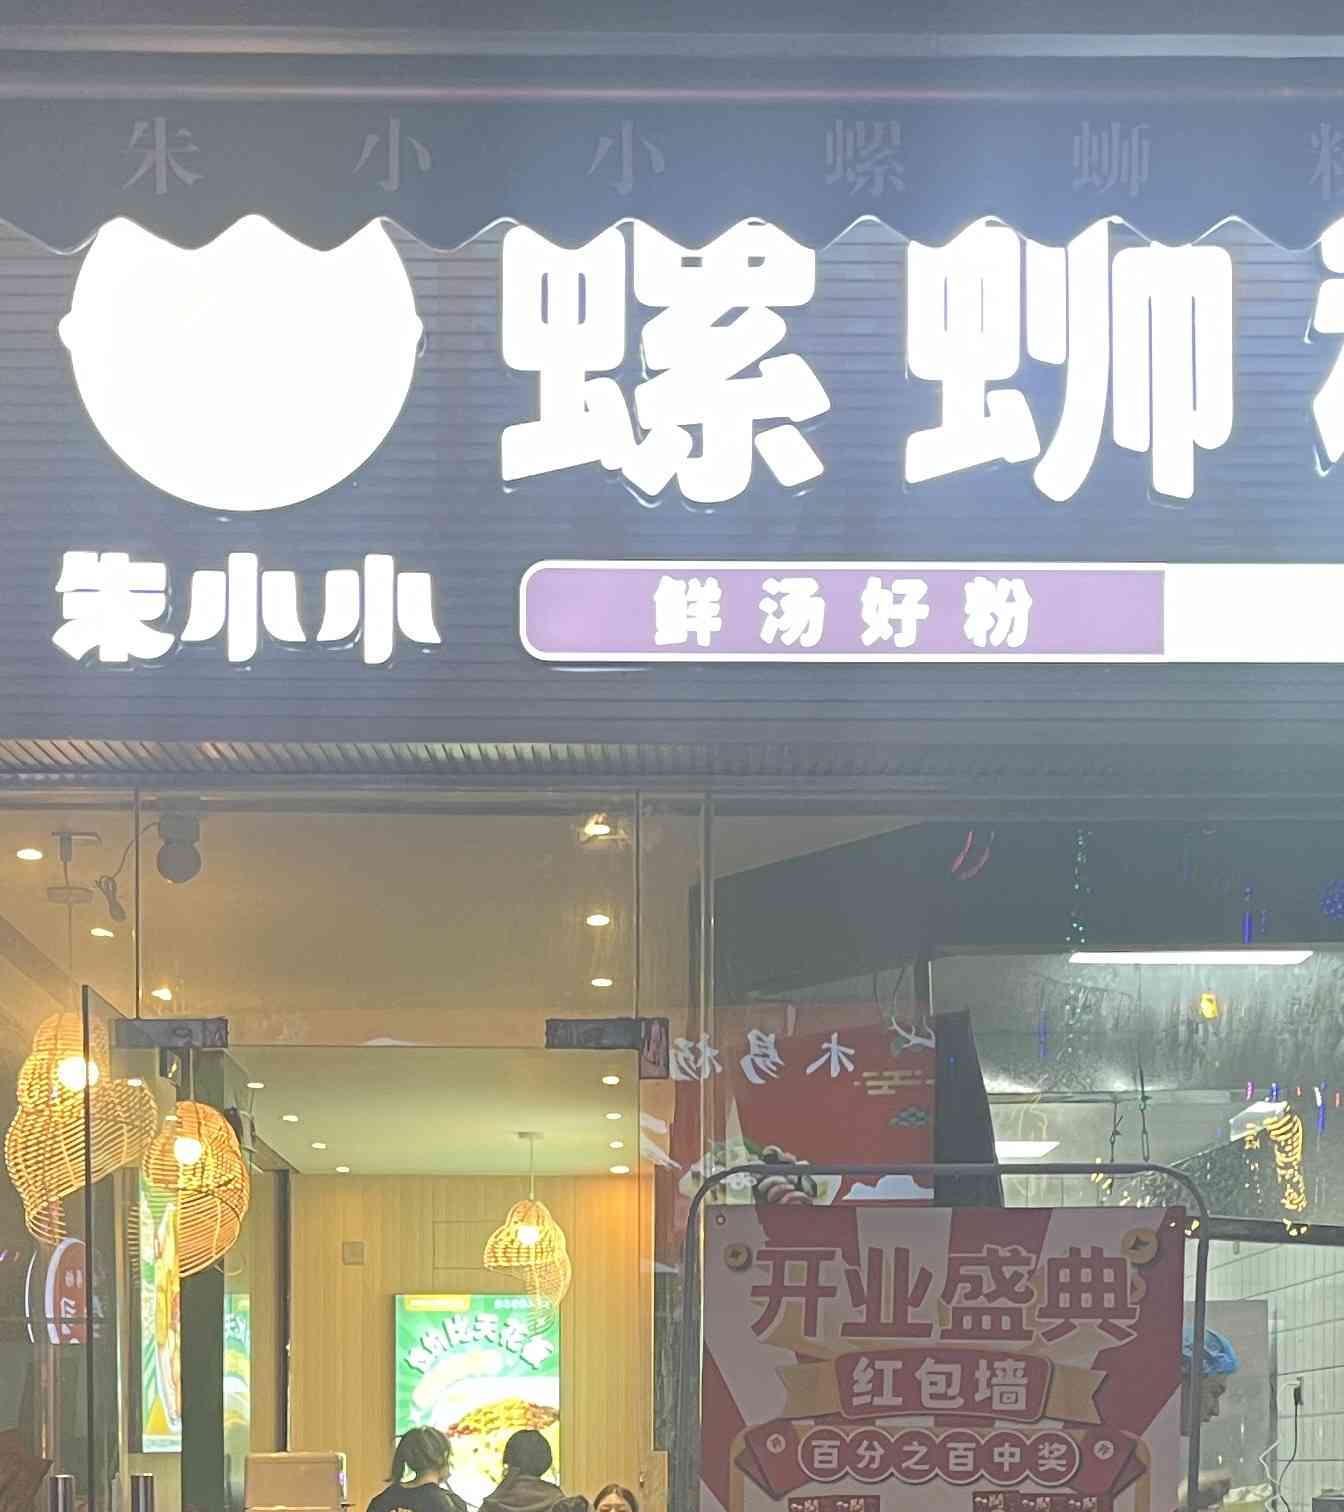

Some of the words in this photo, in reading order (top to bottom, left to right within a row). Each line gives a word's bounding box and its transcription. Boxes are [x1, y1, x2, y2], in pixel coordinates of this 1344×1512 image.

[52, 549, 443, 665] 朱小小
[653, 574, 1035, 648] 鲜汤好粉
[750, 1243, 1140, 1344] 开业盛典
[852, 1357, 1030, 1411] 红包墙
[810, 1437, 1070, 1474] 百分之百中奖
